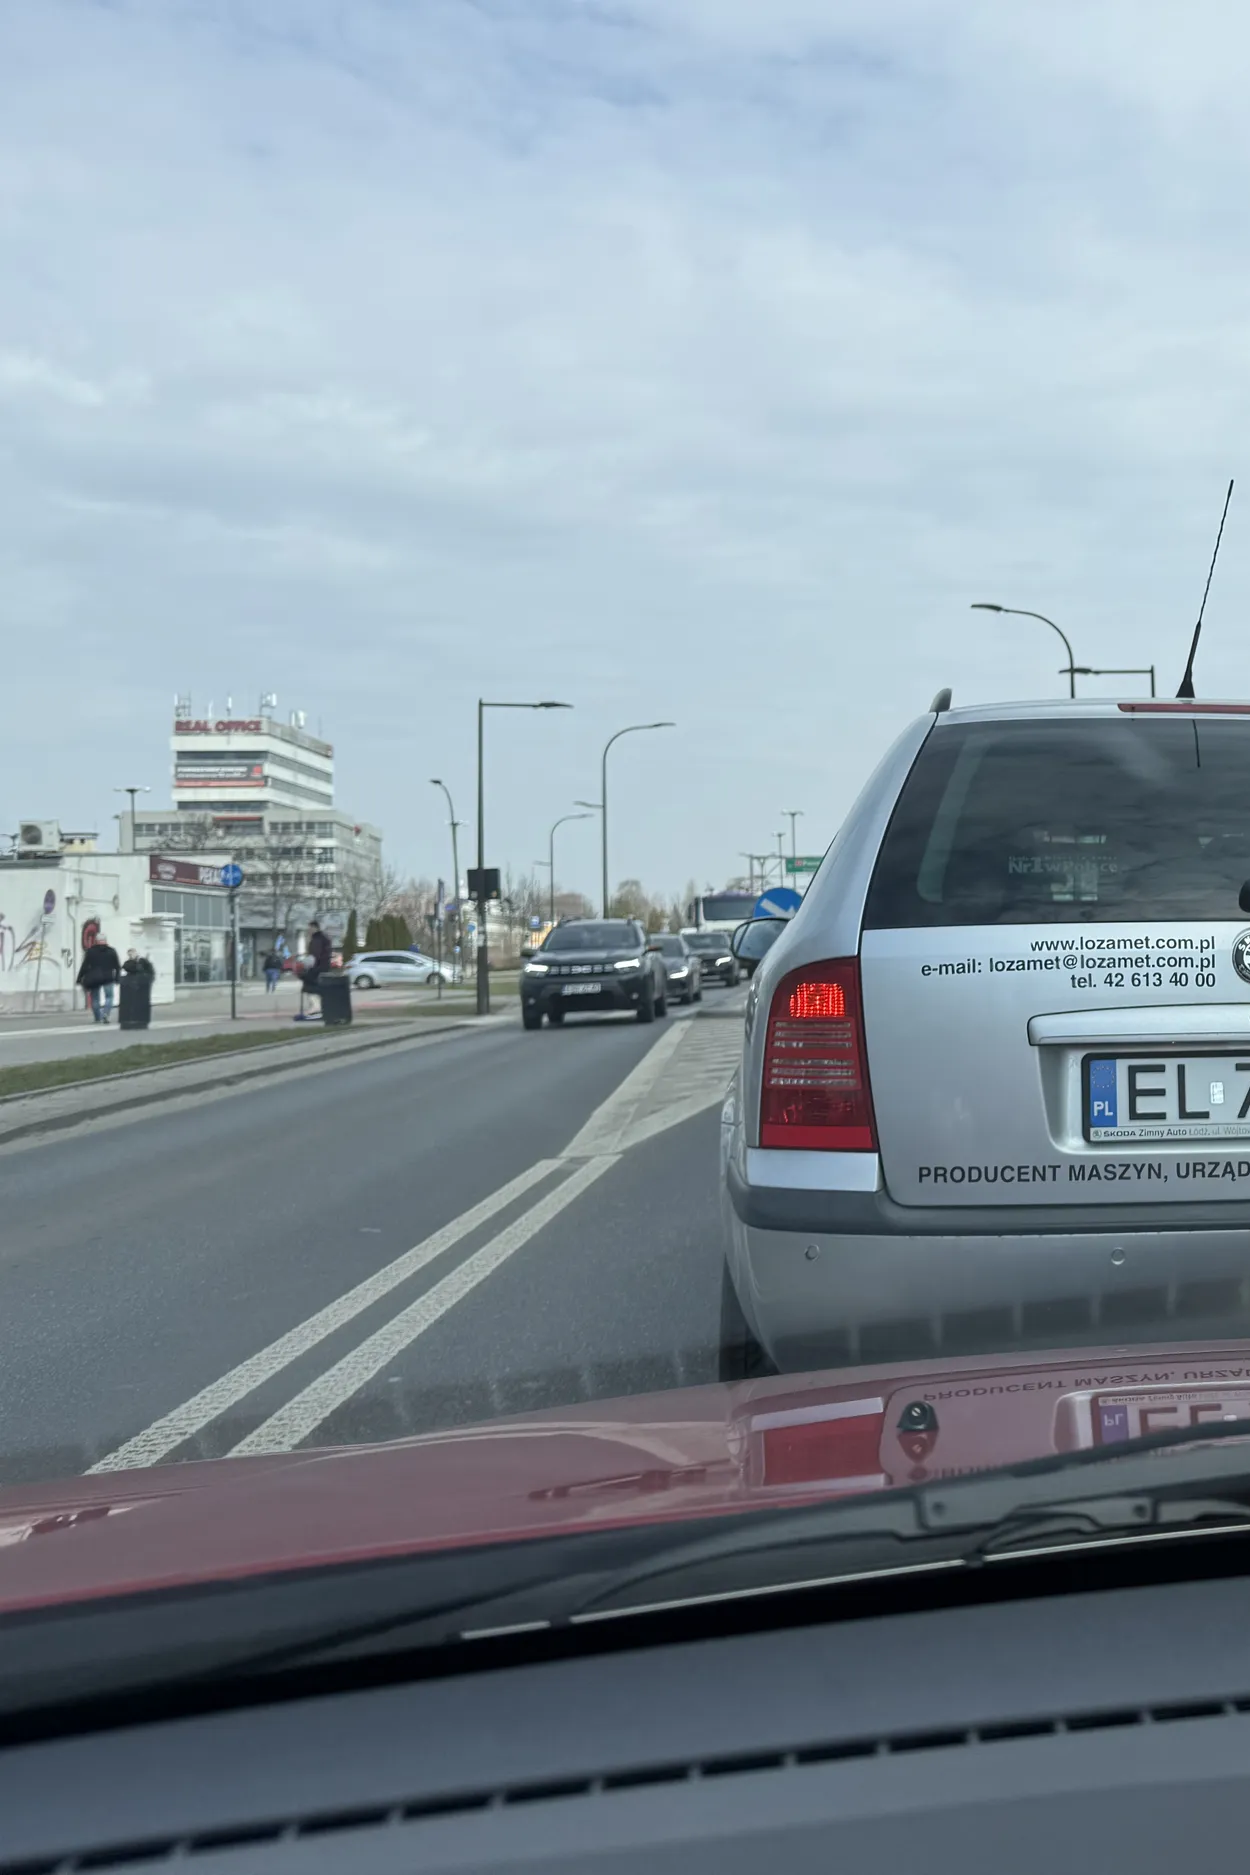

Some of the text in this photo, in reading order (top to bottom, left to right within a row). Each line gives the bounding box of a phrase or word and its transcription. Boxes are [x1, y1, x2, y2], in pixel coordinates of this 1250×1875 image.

[175, 720, 262, 732] REAL OFFICE
[1030, 936, 1216, 953] www.lozamet.com.pl
[921, 954, 1216, 977] e-mail: lozamet@lozamet.com.pl
[1071, 972, 1216, 988] tel. 42 613 40 00
[1127, 1063, 1210, 1121] EL
[1093, 1101, 1114, 1117] PL
[1138, 1128, 1164, 1138] Zimny
[1166, 1128, 1187, 1137] Auto
[918, 1164, 1062, 1183] PRODUCENT
[1068, 1162, 1168, 1183] MASZYN,
